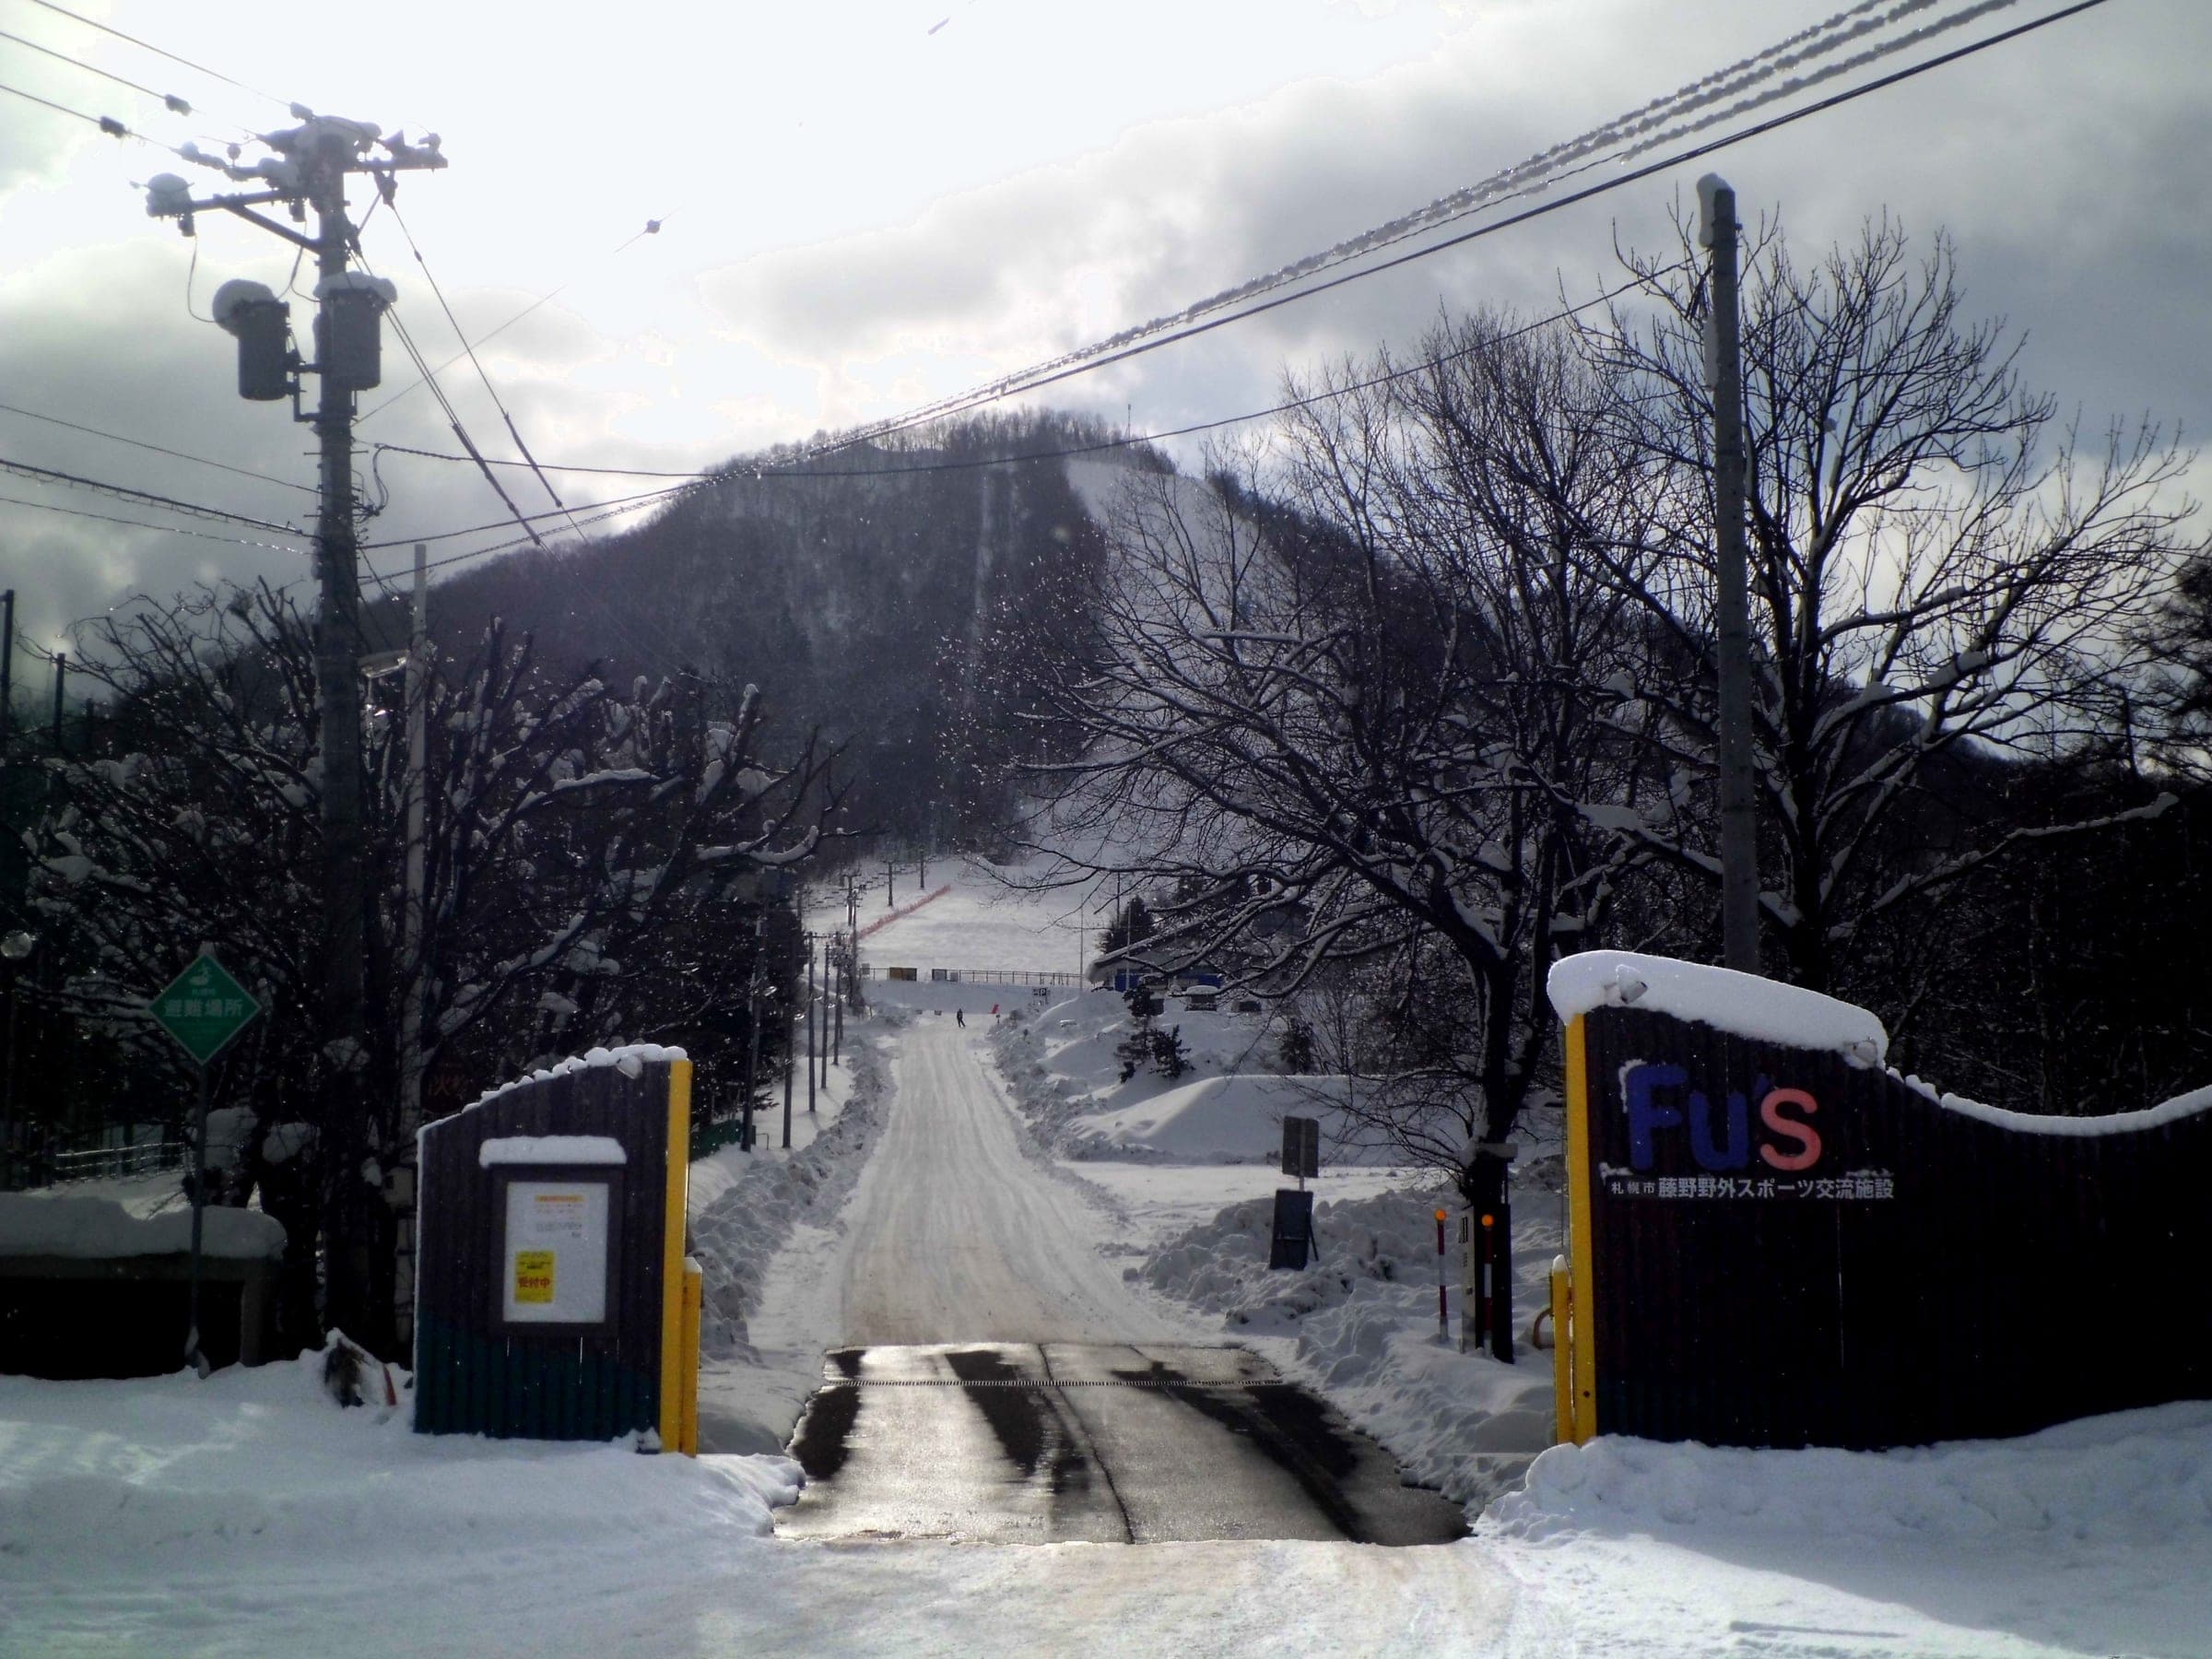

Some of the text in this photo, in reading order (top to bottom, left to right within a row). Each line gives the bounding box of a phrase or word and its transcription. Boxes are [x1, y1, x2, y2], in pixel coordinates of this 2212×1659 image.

[1658, 1177, 1895, 1199] 藤野野外スポーツ交流施設
